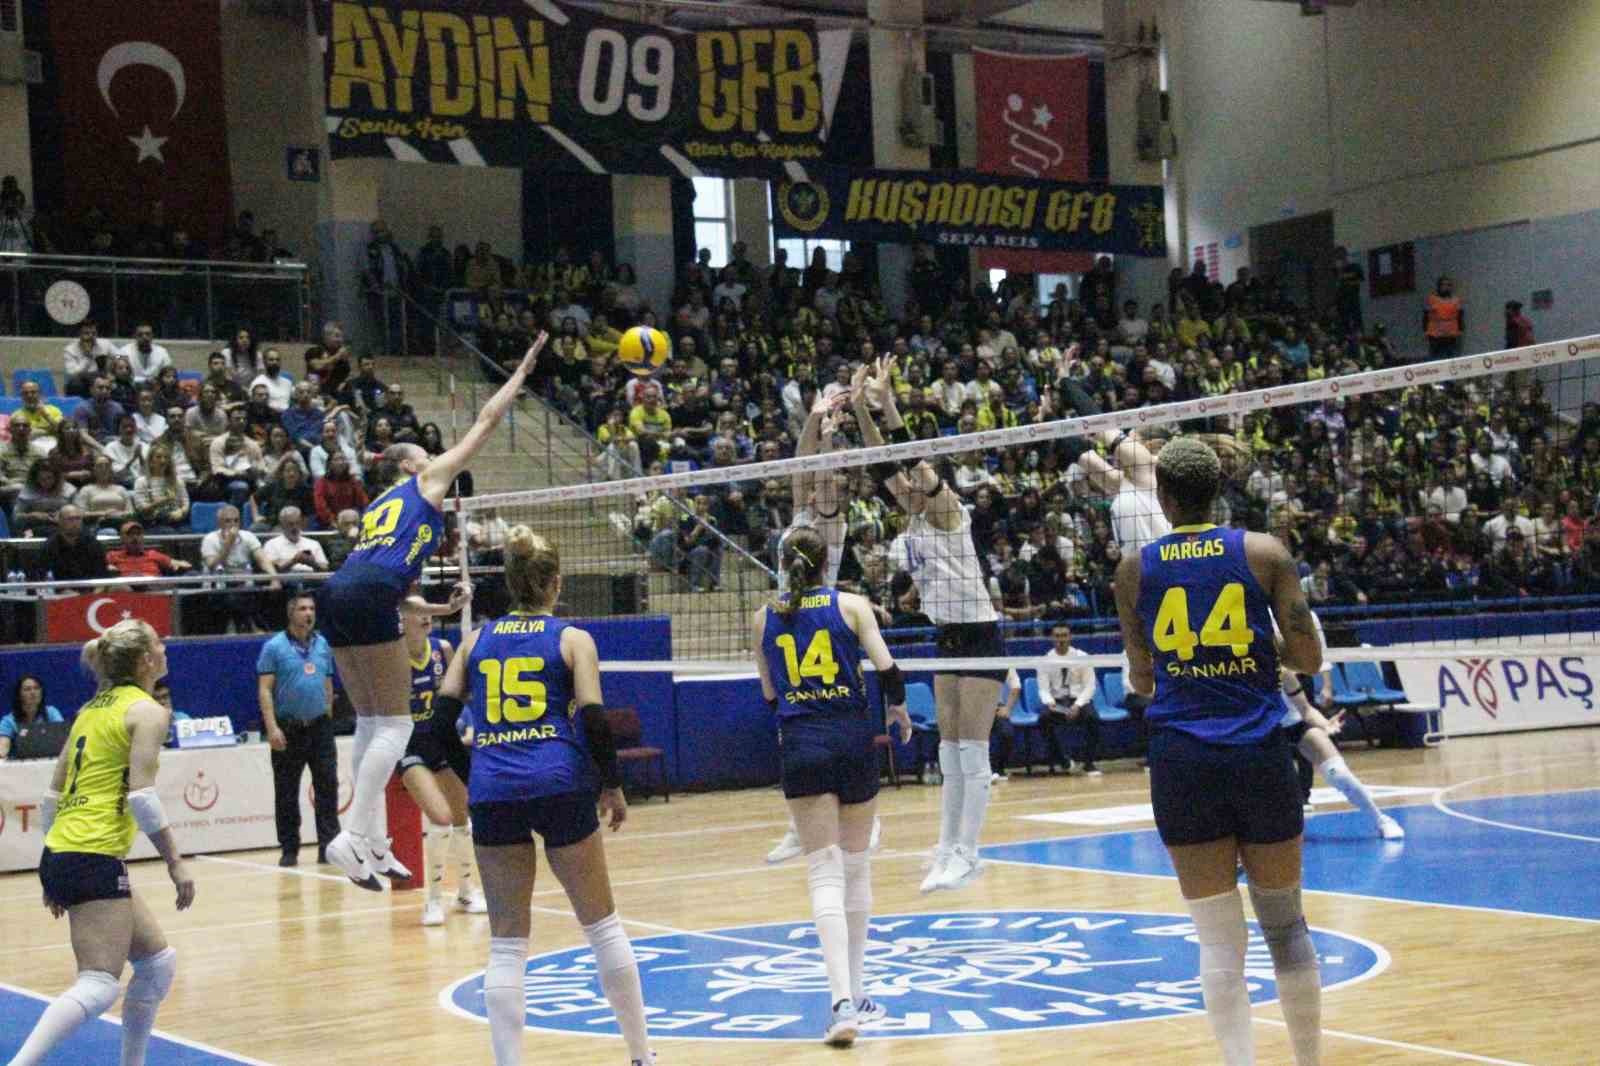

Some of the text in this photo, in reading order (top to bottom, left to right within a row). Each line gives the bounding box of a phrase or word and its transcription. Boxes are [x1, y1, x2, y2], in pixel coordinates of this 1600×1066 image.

[329, 2, 822, 132] AYDIN 09 GFB
[844, 177, 1035, 230] KUŞADASI
[1043, 192, 1116, 234] GFB
[937, 231, 988, 246] SEFA
[1159, 538, 1225, 561] VARGAS
[800, 594, 831, 608] RDEM
[493, 620, 545, 634] ARELYA
[1152, 582, 1254, 661] 44
[775, 628, 839, 687] 14
[478, 656, 547, 724] 15
[785, 685, 850, 704] SANMAR
[476, 724, 558, 748] SANMAR
[69, 735, 87, 794] 1
